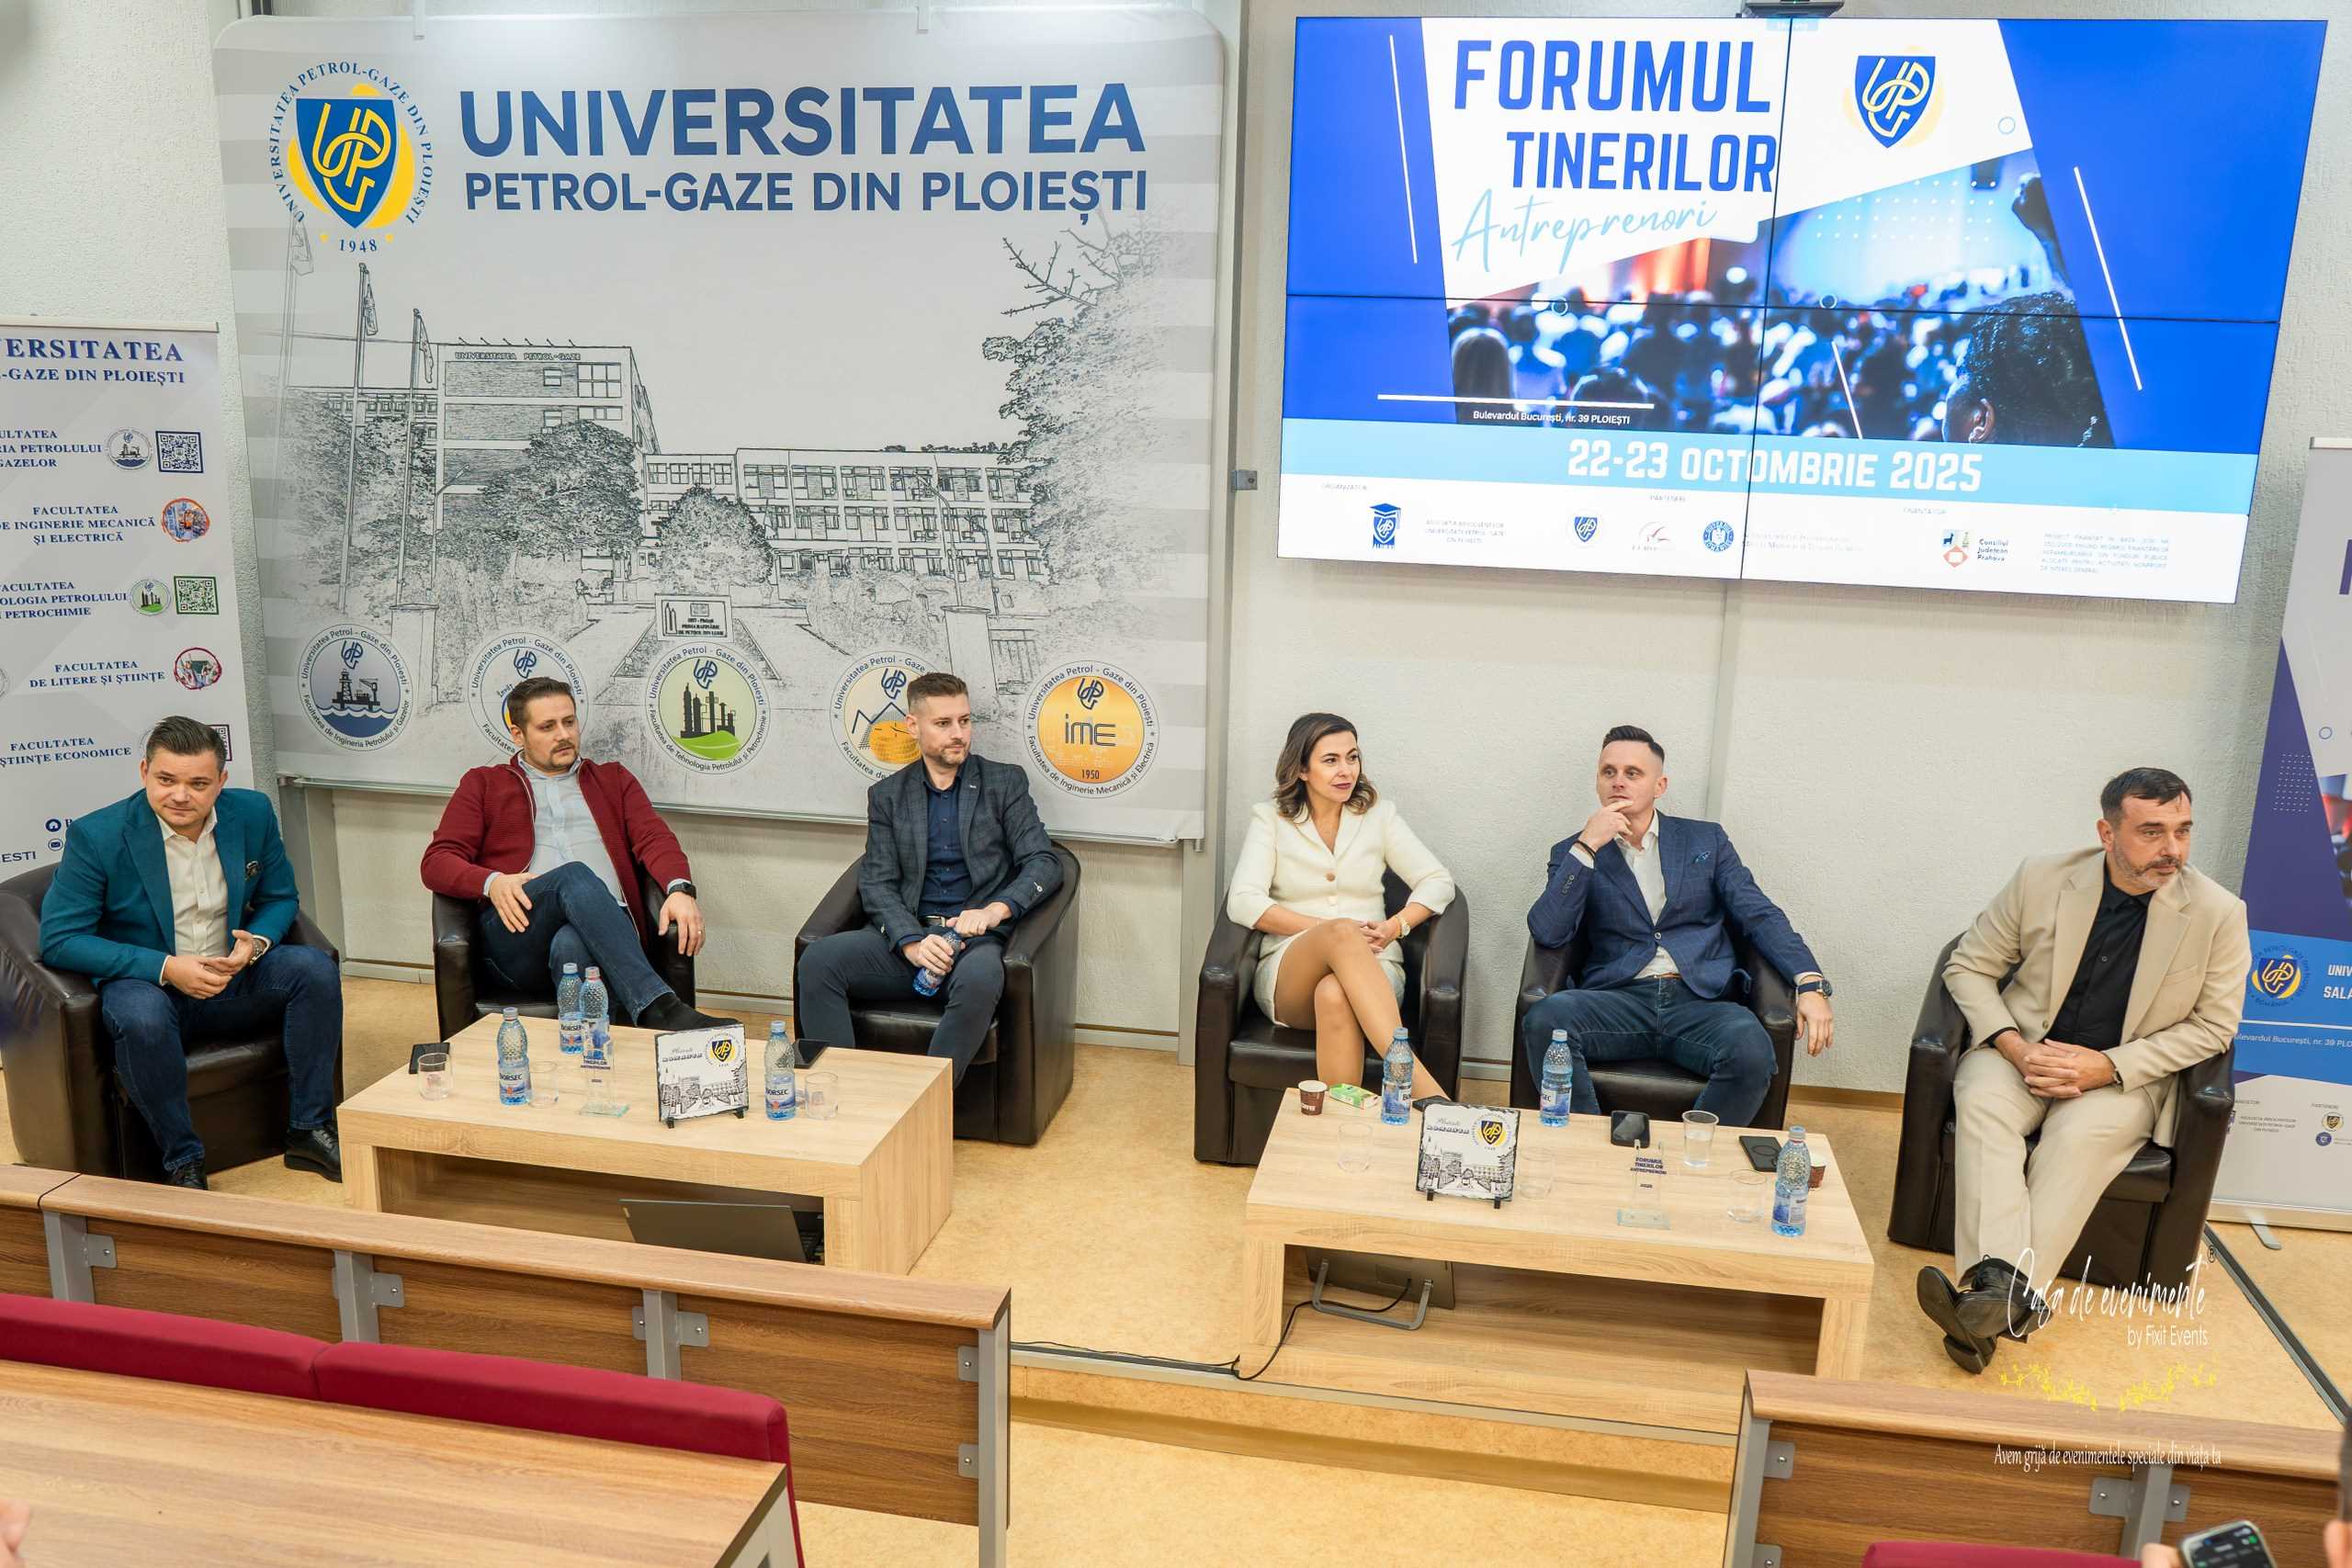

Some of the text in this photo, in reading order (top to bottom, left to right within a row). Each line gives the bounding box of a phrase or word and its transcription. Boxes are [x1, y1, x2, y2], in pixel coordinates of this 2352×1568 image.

[1454, 39, 1770, 113] FORUMUL
[459, 83, 1147, 157] UNIVERSITATEA
[269, 84, 305, 222] UNIVERSITATEA
[298, 62, 410, 104] PETROL-GAZE
[407, 105, 428, 136] DIN
[1507, 131, 1778, 193] TINERILOR
[465, 169, 1147, 226] PETROL-GAZE DIN PLOIEȘTI
[1451, 187, 1718, 275] Antreprenori
[339, 239, 378, 253] 1948
[0, 338, 184, 362] ERSITATEA
[0, 367, 185, 386] -GAZE DIN PLOIEȘTI
[1473, 410, 1519, 421] Bulevardul
[1577, 413, 1589, 423] 39
[1590, 414, 1631, 426] PLOIEȘTI
[20, 444, 103, 454] PETROLULUI
[1567, 437, 1984, 492] 22-23 OCTOMBRIE 2025
[32, 505, 119, 515] FACULTATEA
[14, 520, 85, 530] INGINERIE
[87, 516, 156, 529] MECANICĂ
[33, 531, 124, 546] ȘI ELECTRICĂ
[0, 581, 75, 592] ACULTATEA
[51, 592, 128, 604] PETROLULUI
[6, 607, 92, 619] PETROCHIMIE
[330, 627, 354, 638] Petrol
[360, 630, 379, 643] Gaze
[379, 642, 392, 654] din
[502, 637, 526, 647] Petrol
[534, 638, 554, 652] Gaze
[554, 651, 567, 664] din
[54, 660, 139, 672] FACULTATEA
[682, 645, 707, 656] Petrol
[716, 649, 735, 662] Gaze
[736, 660, 749, 675] din
[29, 678, 47, 688] DE
[51, 675, 97, 687] LITERE
[100, 675, 112, 685] ȘI
[834, 655, 926, 710] Universitatea Petrol Gaze
[1028, 671, 1065, 720] Universitatea
[1066, 664, 1093, 675] Petrol
[1102, 668, 1124, 682] Gaze
[1124, 679, 1138, 694] din
[324, 728, 334, 737] de
[10, 737, 95, 751] FACULTATEA
[666, 742, 675, 752] de
[55, 747, 131, 761] ECONOMICE
[840, 741, 874, 775] Facultatea
[1049, 772, 1059, 781] de
[1081, 769, 1100, 780] 1950
